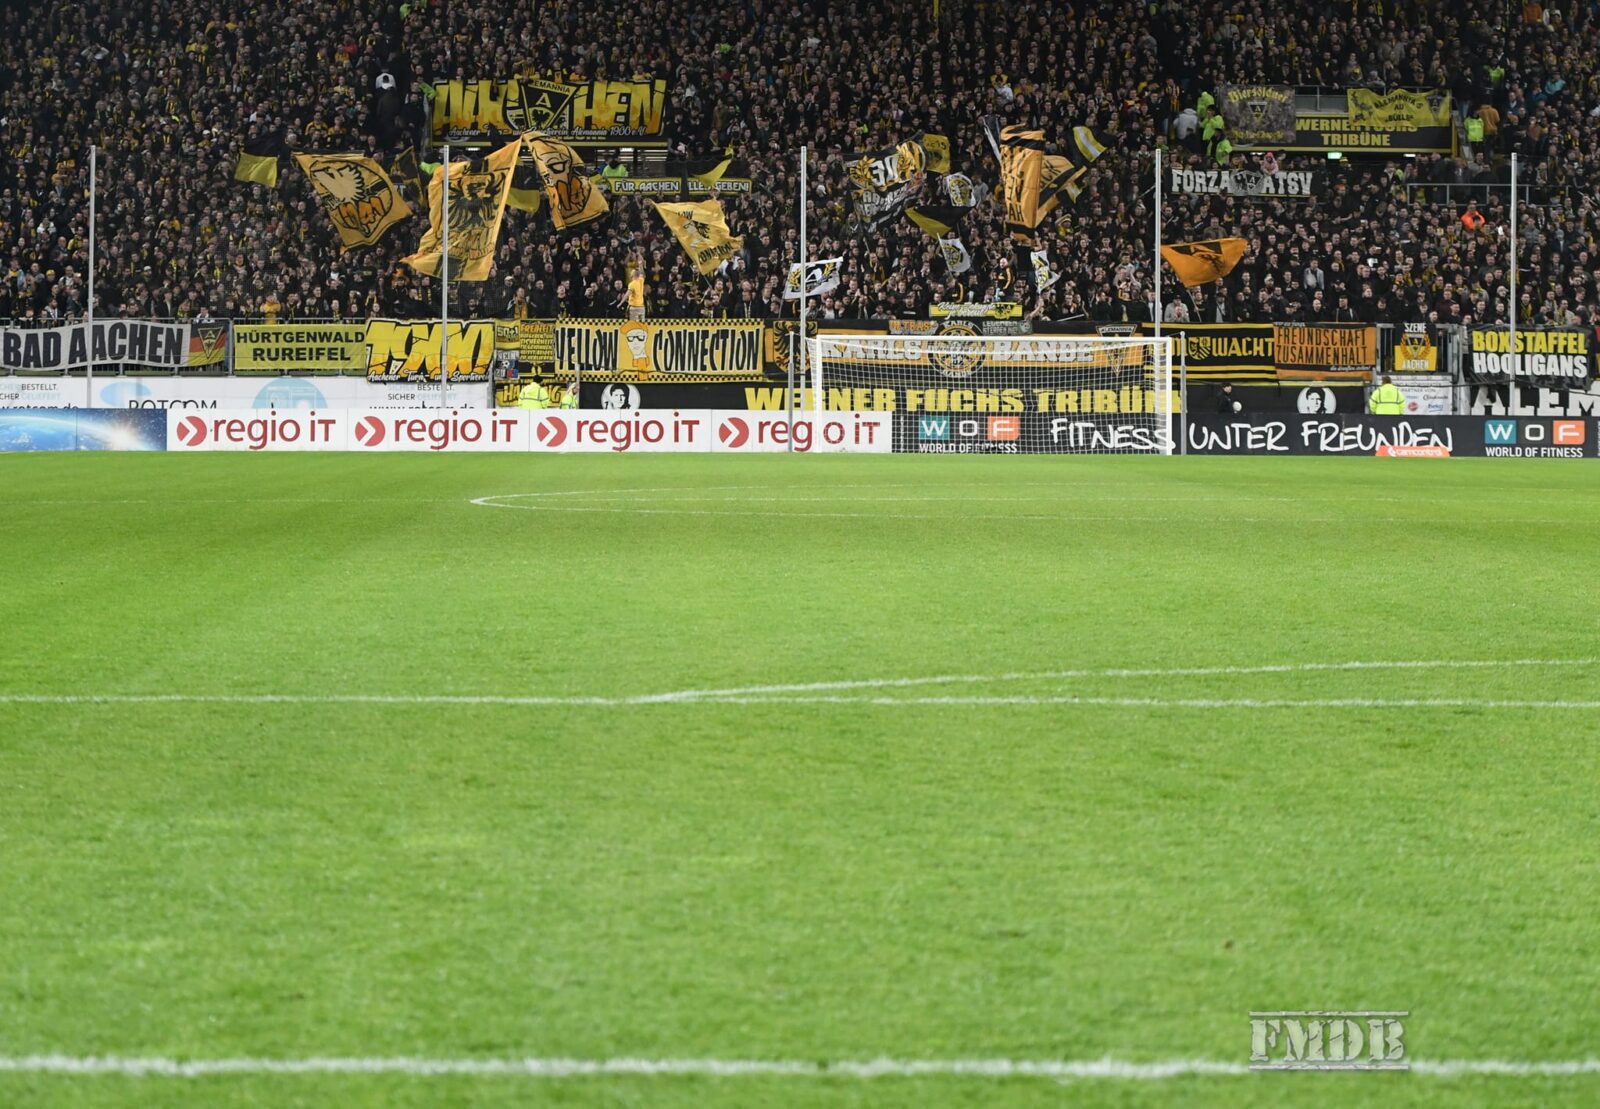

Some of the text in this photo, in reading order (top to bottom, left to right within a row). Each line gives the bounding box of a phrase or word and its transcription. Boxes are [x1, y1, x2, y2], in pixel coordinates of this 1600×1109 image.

[609, 125, 631, 136] 1900
[1296, 119, 1369, 131] WERNE
[1321, 131, 1391, 146] TRIBÜNE
[615, 180, 749, 192] FÜR AACHEN LLE GEBEN!
[1171, 168, 1313, 195] FORZA ATSV
[236, 329, 365, 344] HÜRTGENWALD
[1277, 326, 1367, 346] FREUNDSCHAFT
[1404, 322, 1427, 334] SZENE
[3, 321, 184, 369] BAD AACHEN
[555, 327, 760, 372] YELLOW CONNECTION
[1211, 337, 1275, 357] WACHT
[1472, 331, 1588, 354] BOXSTAFFEL
[252, 347, 352, 362] RUREIFEL
[1276, 345, 1368, 365] ZUSAMMENHALT
[1401, 359, 1429, 371] AACHEN
[1472, 352, 1588, 378] HOOLIGANS
[388, 393, 416, 401] SICHER
[906, 387, 1025, 413] FUCHS
[214, 410, 336, 450] regio iT
[394, 410, 518, 451] regio iT
[576, 411, 700, 452] regio iT
[758, 418, 846, 453] rego
[853, 413, 880, 444] iT
[1050, 418, 1453, 452] FITNESS UNTER FREUNDEN
[919, 442, 956, 453] WORLD
[959, 442, 972, 453] OF
[1485, 446, 1584, 458] WORLD OF FITNESS
